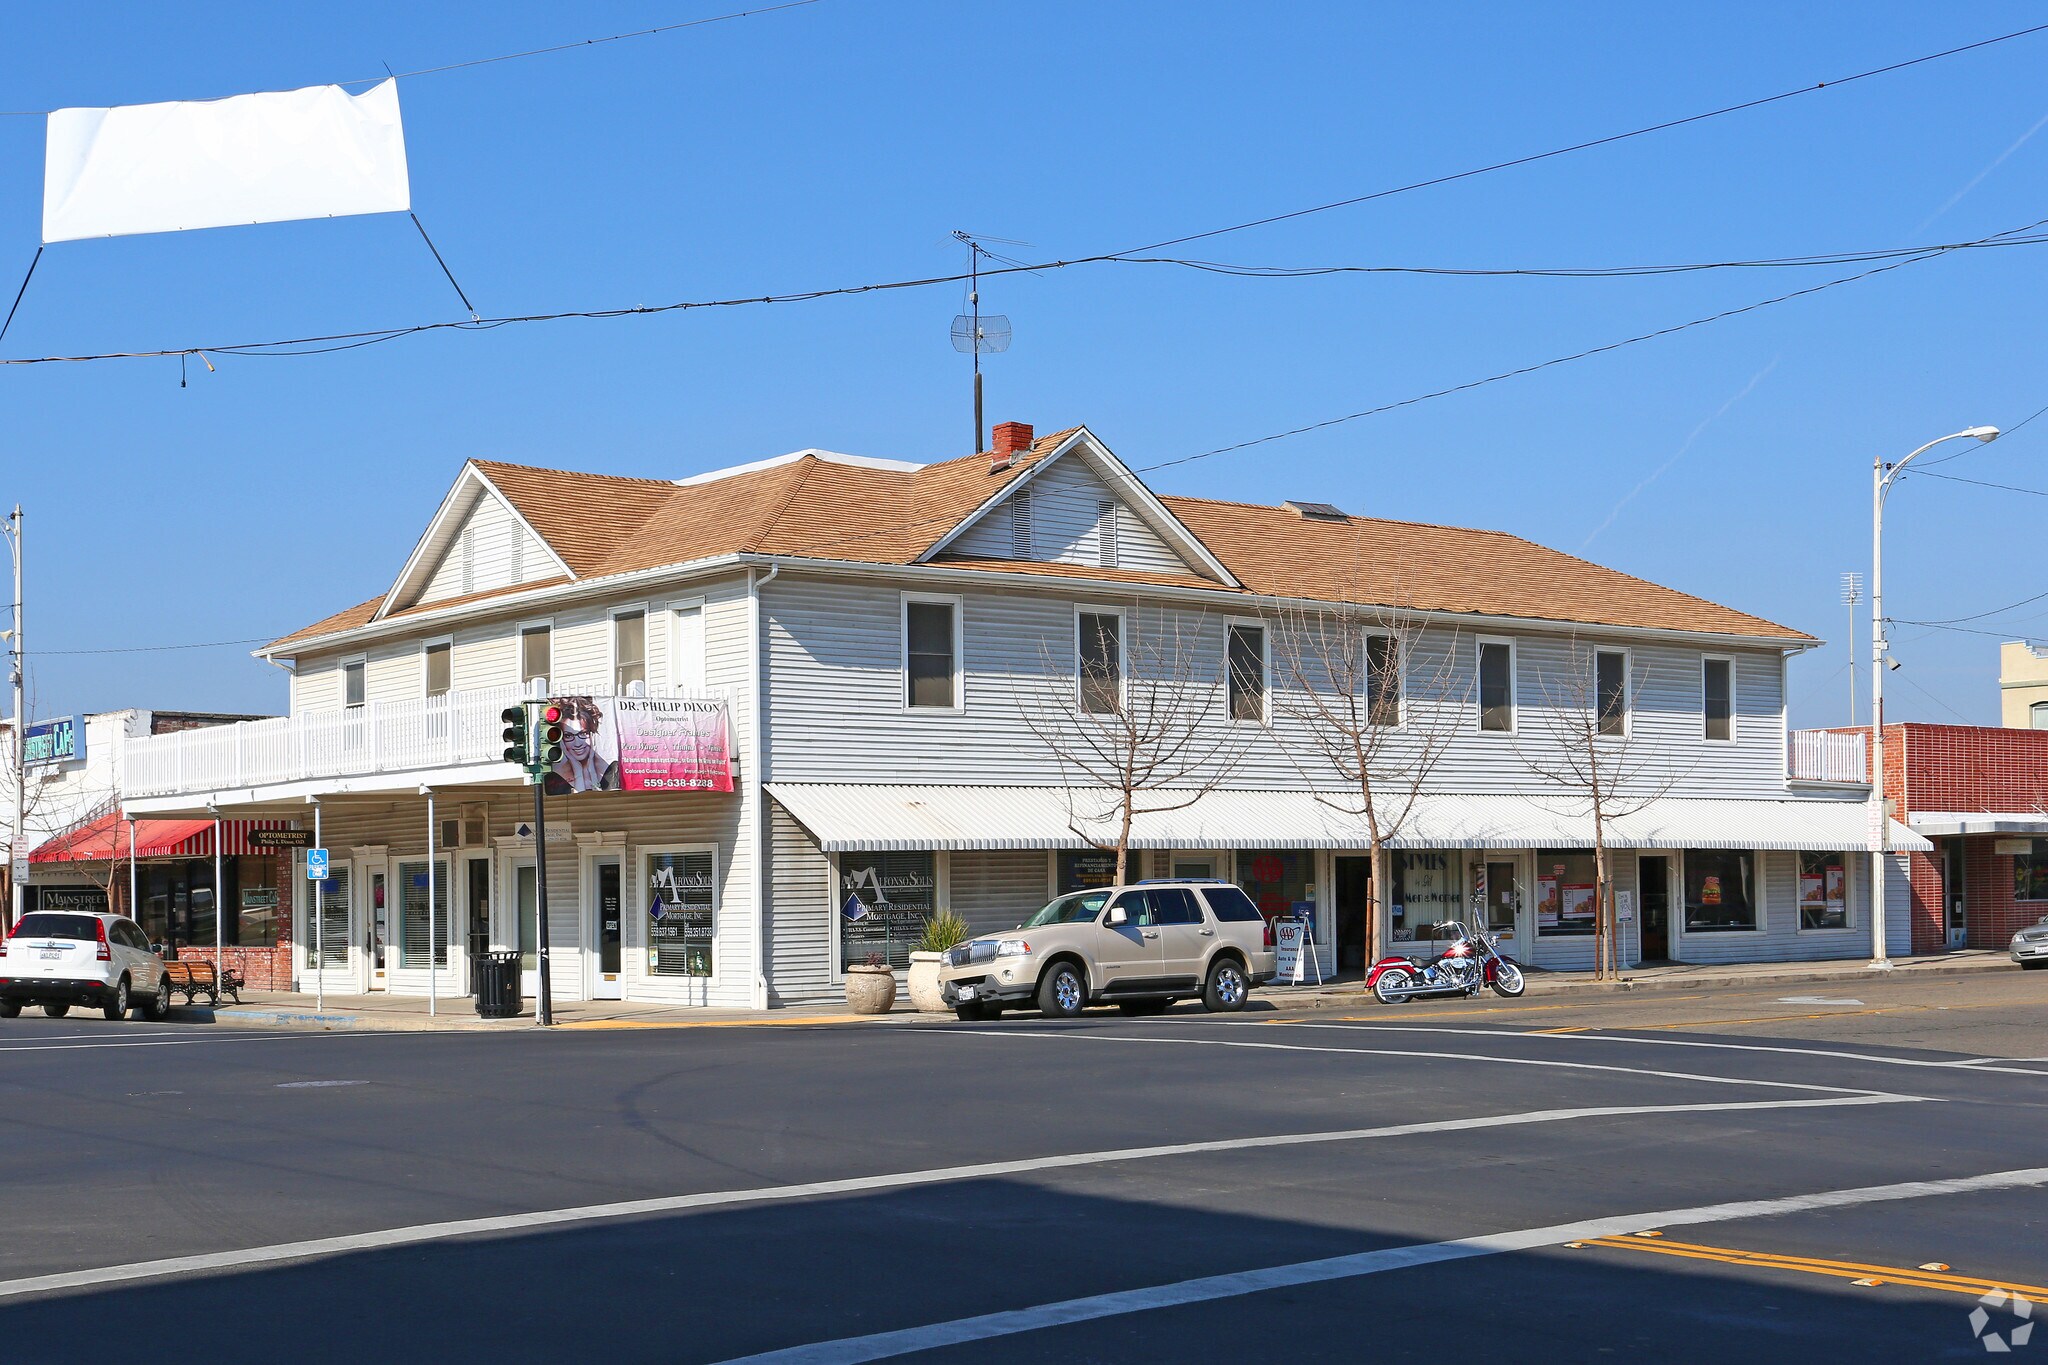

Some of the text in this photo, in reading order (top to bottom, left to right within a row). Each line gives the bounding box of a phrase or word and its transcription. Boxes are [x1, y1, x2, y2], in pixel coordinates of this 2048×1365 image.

[620, 701, 720, 713] DR. PHILIP DIXON
[636, 728, 711, 738] Designer Frames
[638, 743, 659, 752] Wang
[848, 867, 933, 903] ALFONSO SOLIS
[47, 893, 107, 905] MAINSTREET
[1405, 893, 1423, 903] Men
[1431, 892, 1461, 903] Women
[681, 903, 711, 911] RESIDENTIAL
[866, 912, 907, 920] MORTGAGE,
